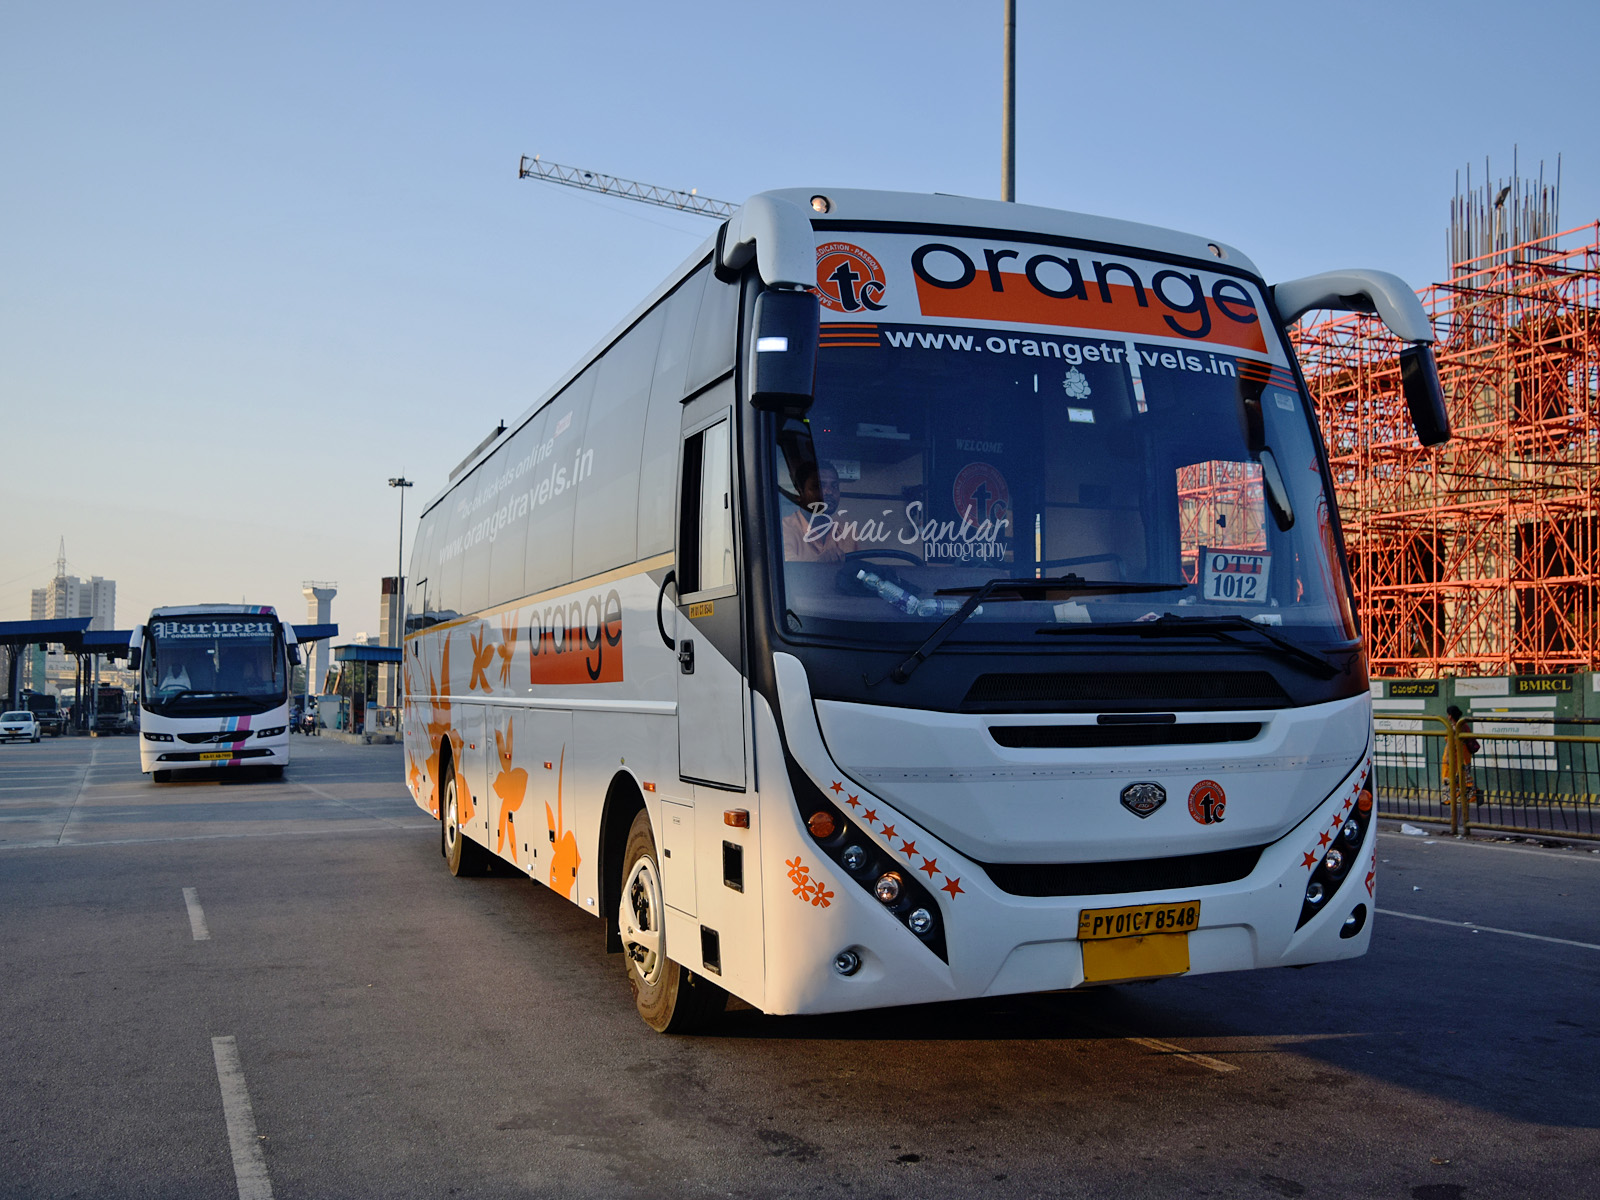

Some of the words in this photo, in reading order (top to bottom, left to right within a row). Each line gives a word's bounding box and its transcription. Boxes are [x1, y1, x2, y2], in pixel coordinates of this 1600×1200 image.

[816, 244, 850, 257] EDICATION
[854, 248, 880, 271] PASSION
[911, 243, 1258, 339] orange
[884, 329, 1236, 378] www.orangetravels.in
[956, 439, 1004, 453] WELCOME
[439, 448, 594, 566] www.orangetravels.in
[1212, 554, 1264, 573] OTT
[1213, 574, 1258, 599] 1012
[153, 621, 274, 638] Parveen
[529, 588, 623, 681] orange
[1519, 679, 1572, 692] BMRCL
